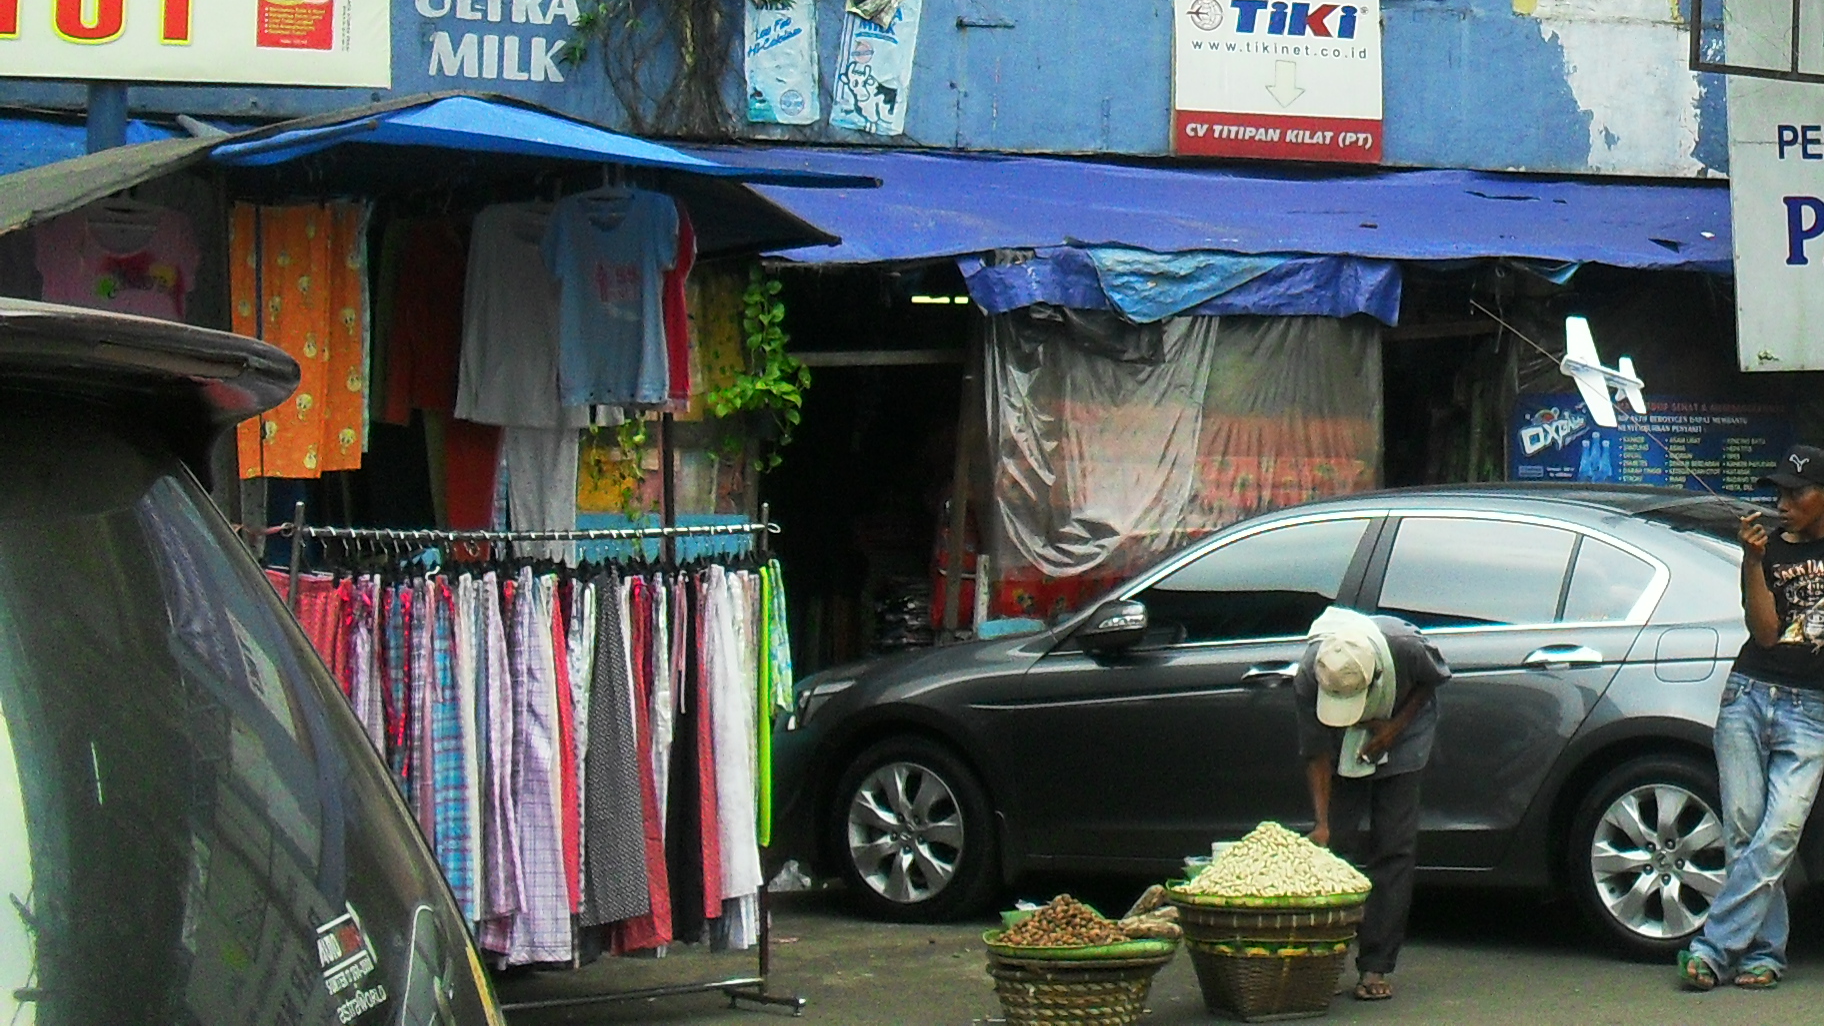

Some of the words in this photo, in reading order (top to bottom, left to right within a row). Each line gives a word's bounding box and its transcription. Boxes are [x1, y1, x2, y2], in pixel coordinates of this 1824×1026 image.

[428, 30, 569, 84] MILK
[1190, 38, 1368, 61] www.tikinet.co.id
[1185, 123, 1208, 140] CV
[1212, 124, 1281, 143] TITIPAN
[1284, 128, 1334, 146] KILAT
[1337, 129, 1373, 151] (PT)
